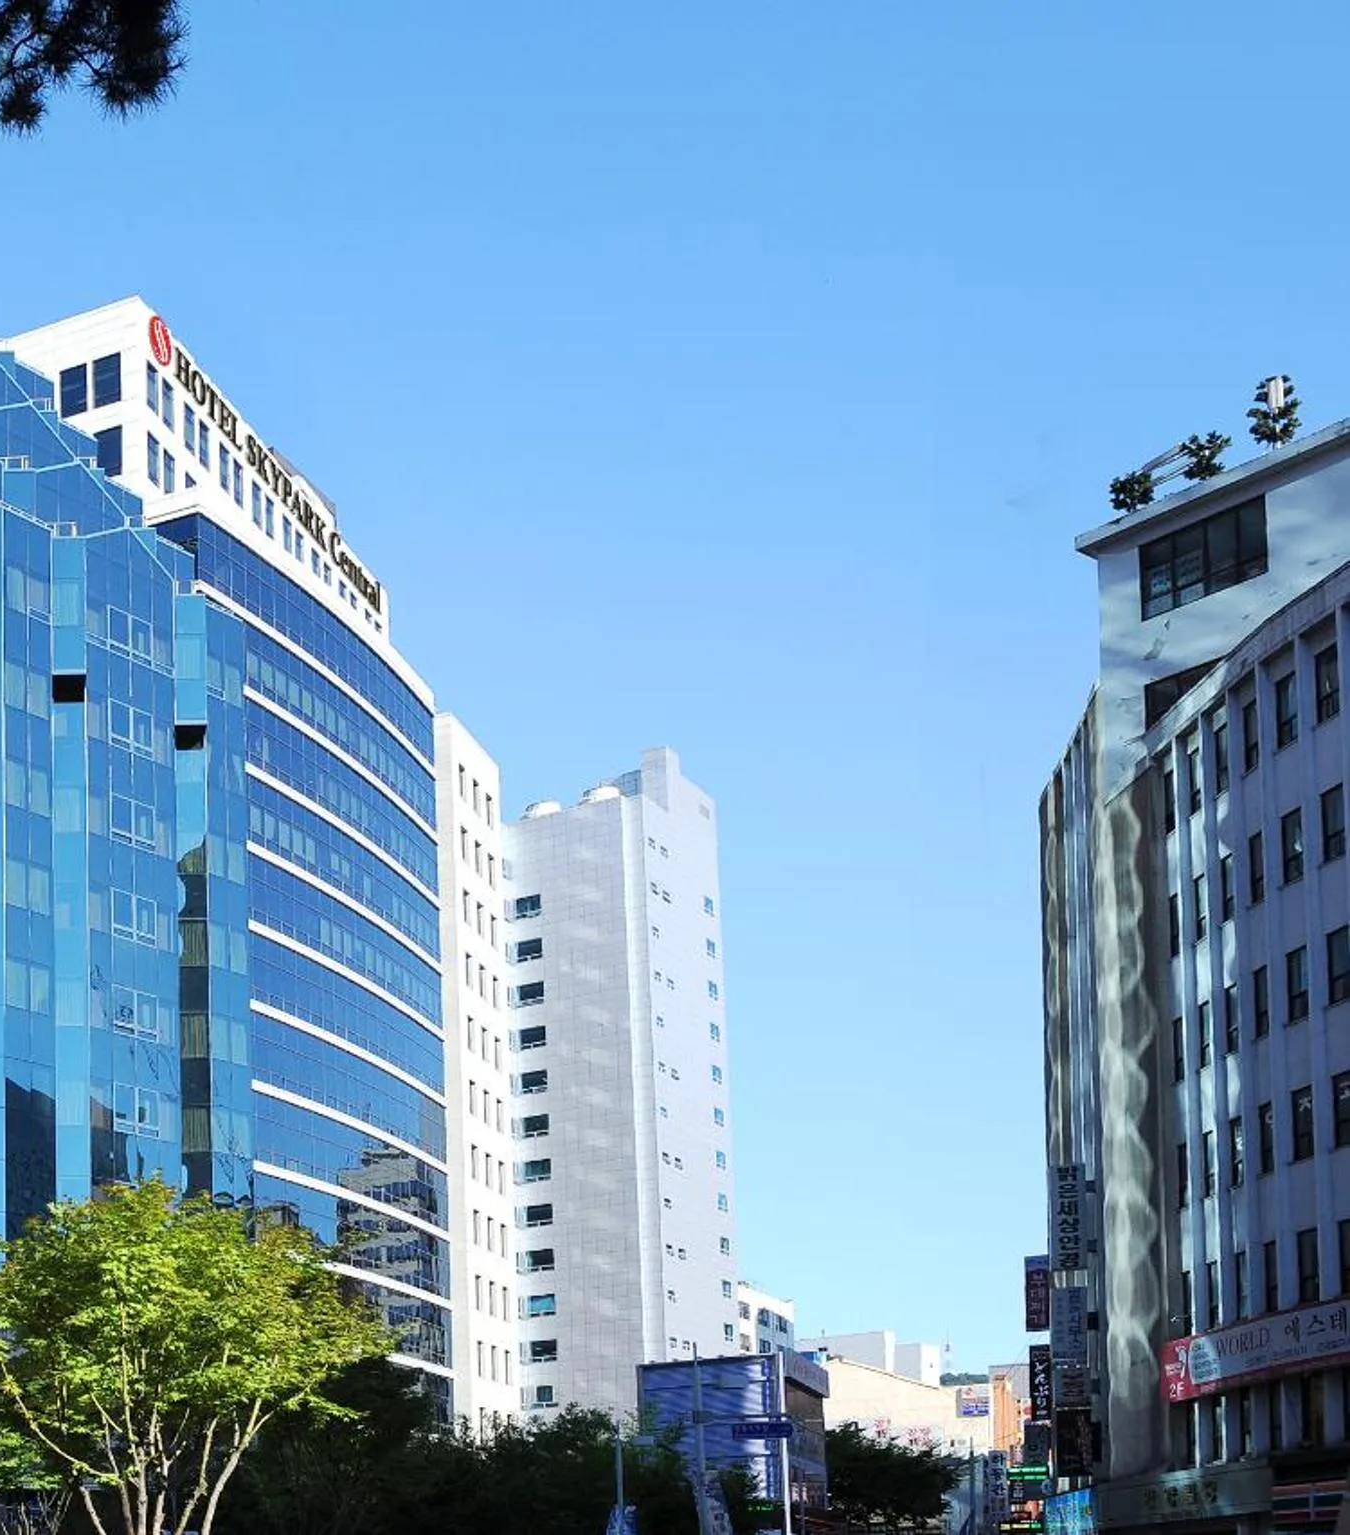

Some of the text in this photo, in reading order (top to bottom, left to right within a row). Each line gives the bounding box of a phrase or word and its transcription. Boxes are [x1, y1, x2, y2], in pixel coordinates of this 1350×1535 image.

[173, 346, 382, 615] HOTEL SKYPARK Central
[1216, 1327, 1270, 1359] WORLD
[1169, 1382, 1185, 1399] 2F
